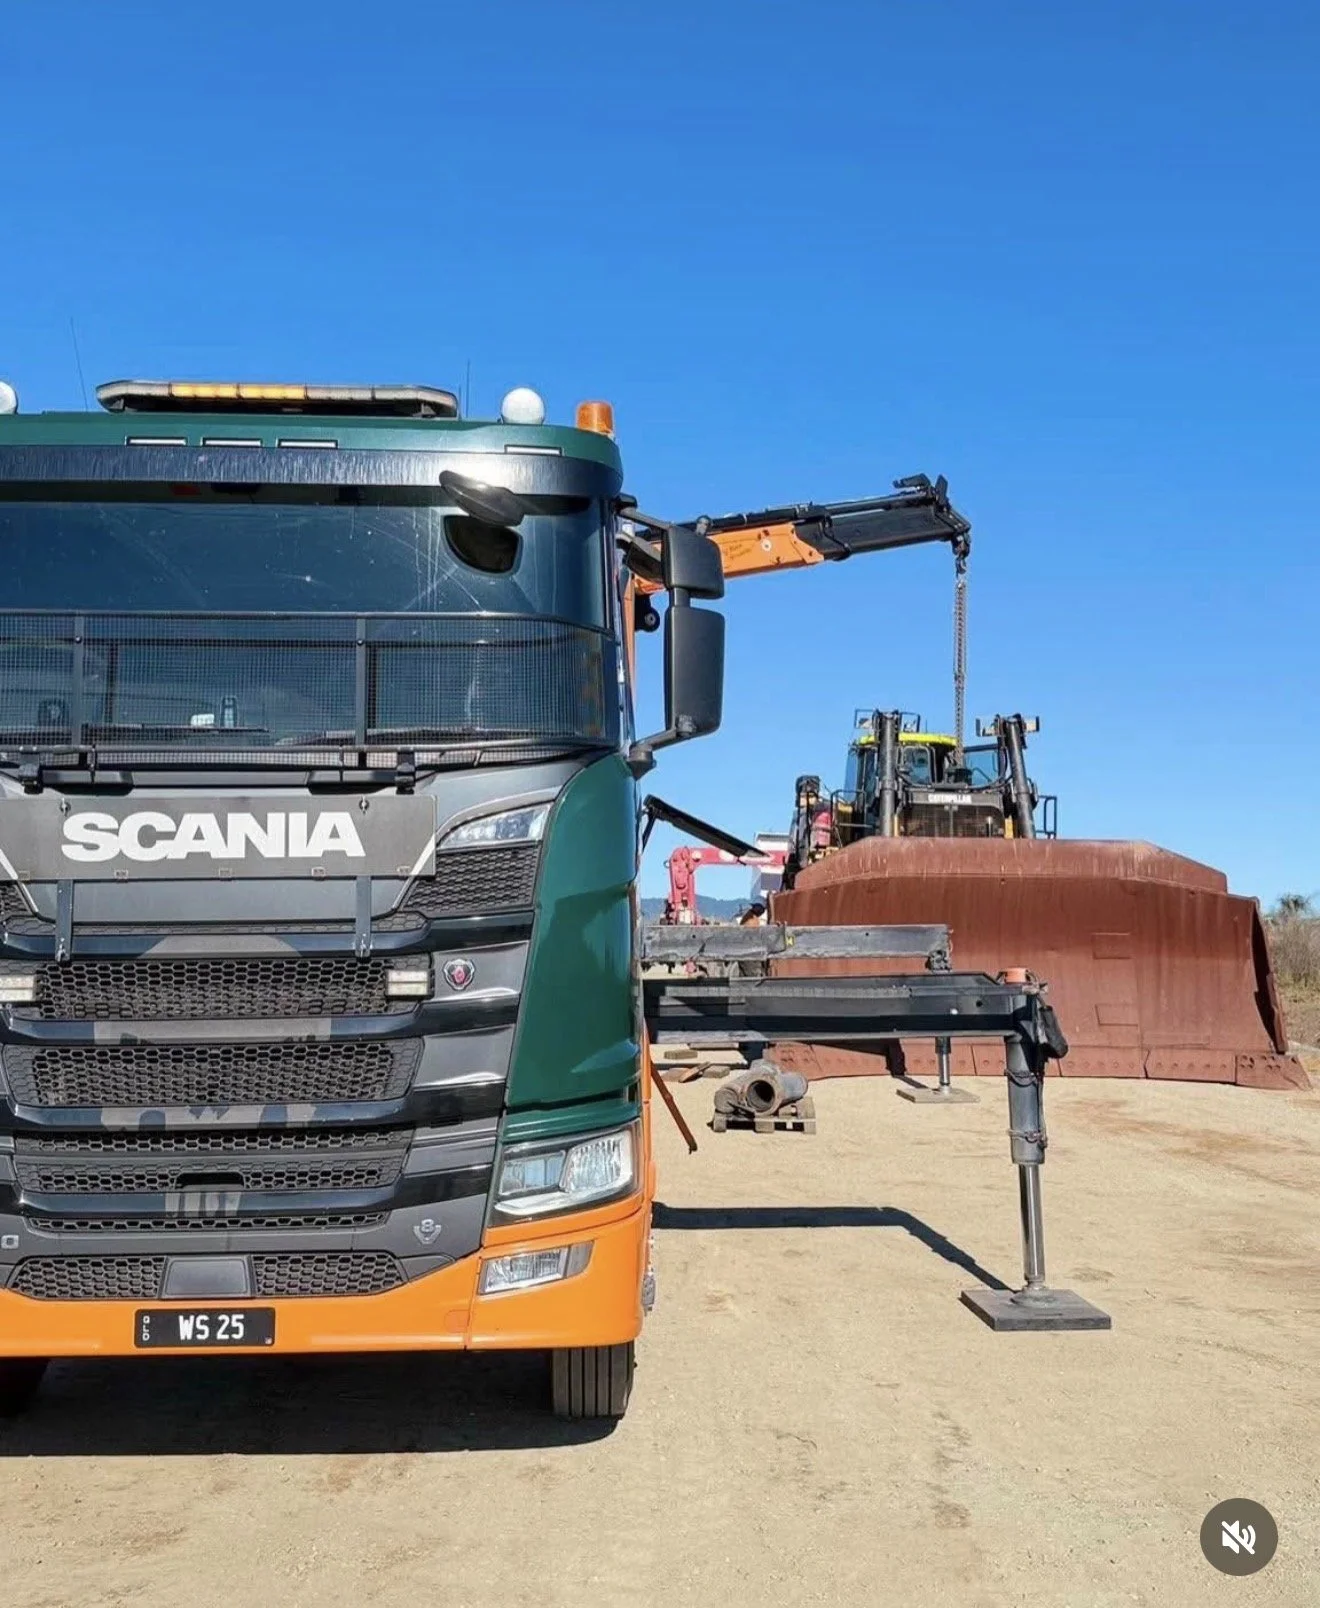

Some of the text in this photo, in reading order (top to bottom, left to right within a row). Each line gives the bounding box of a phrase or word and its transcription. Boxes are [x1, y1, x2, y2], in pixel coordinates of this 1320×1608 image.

[61, 811, 366, 862] SCANIA
[142, 1315, 150, 1341] QLD
[178, 1313, 245, 1341] WS 25
